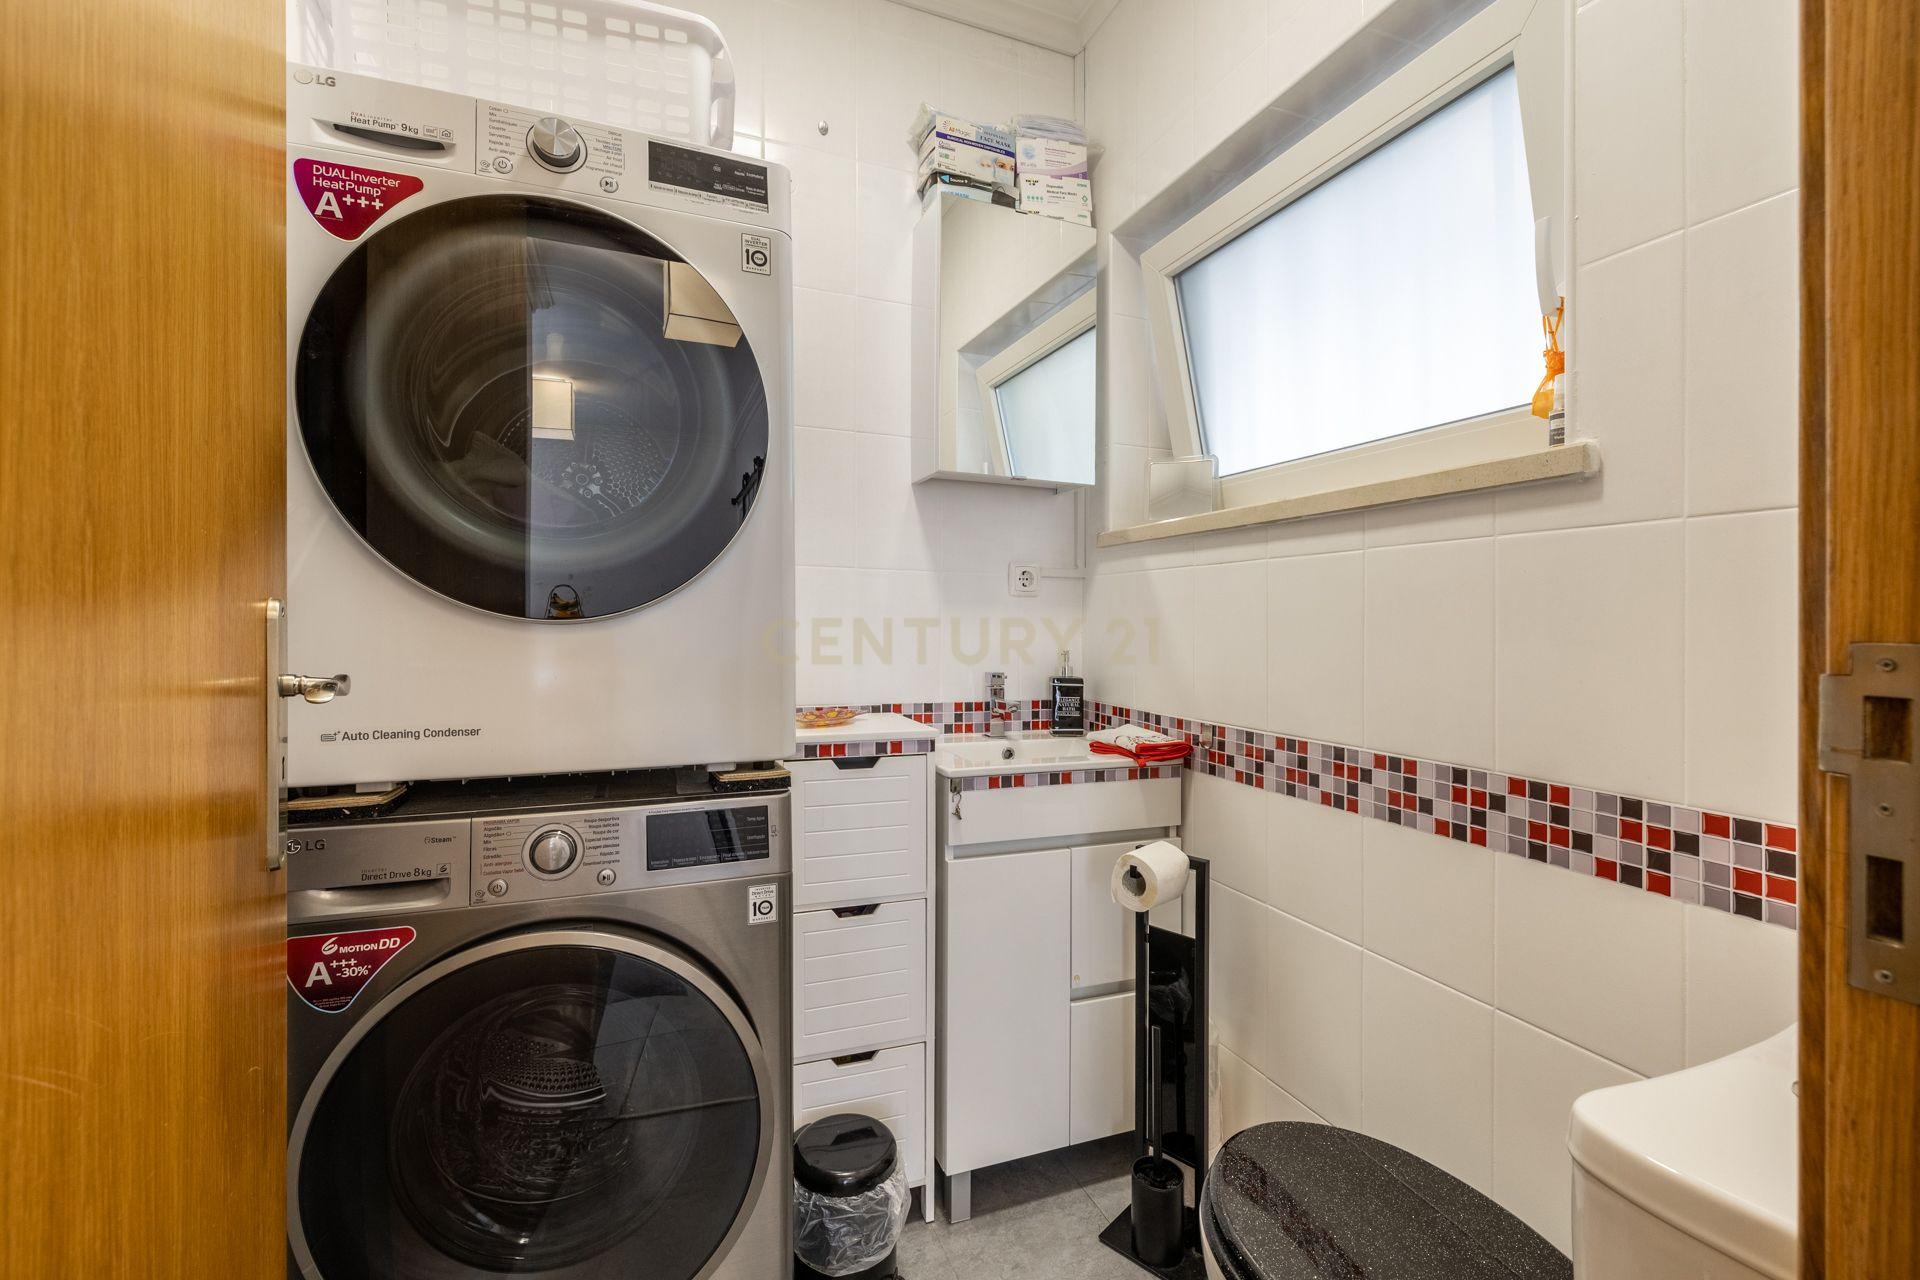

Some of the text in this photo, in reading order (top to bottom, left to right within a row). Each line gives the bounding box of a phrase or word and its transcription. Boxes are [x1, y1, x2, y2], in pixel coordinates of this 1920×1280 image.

[316, 74, 336, 87] LG
[350, 116, 370, 125] Heat
[995, 140, 1011, 149] MASK
[313, 176, 345, 191] Heat
[350, 170, 401, 188] Inverter
[745, 248, 768, 268] 10
[342, 727, 481, 743] Auto Cleaning Condenser
[306, 839, 326, 851] LG
[431, 836, 453, 844] Steam
[361, 867, 432, 882] Direct Drive 8kg
[753, 900, 773, 917] 10
